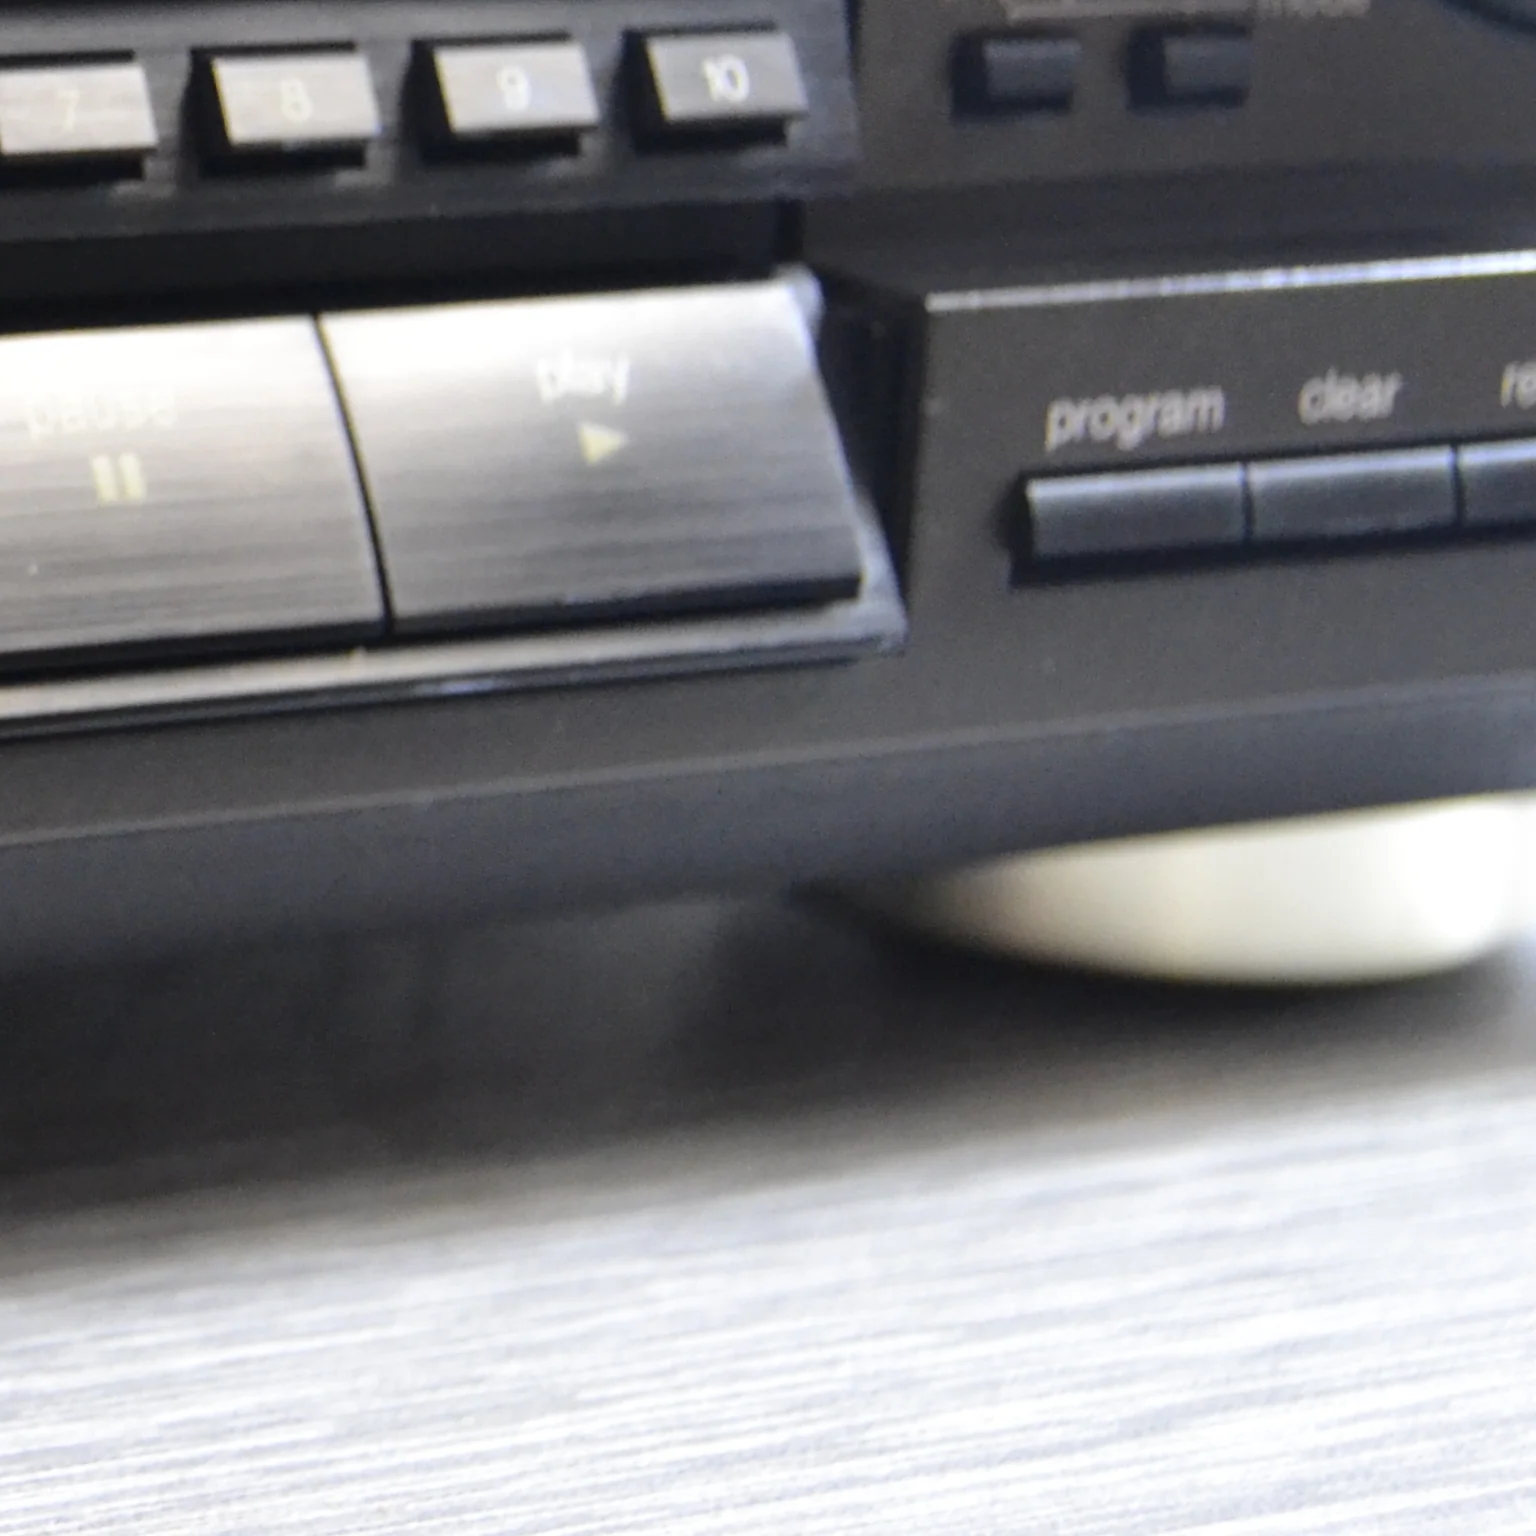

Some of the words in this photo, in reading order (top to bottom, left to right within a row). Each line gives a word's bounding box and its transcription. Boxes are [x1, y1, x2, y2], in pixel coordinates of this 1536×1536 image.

[279, 78, 313, 120] 8
[496, 67, 532, 110] 9
[702, 54, 750, 103] 10
[56, 86, 82, 133] 7
[1045, 388, 1226, 452] program
[1298, 370, 1401, 423] clear
